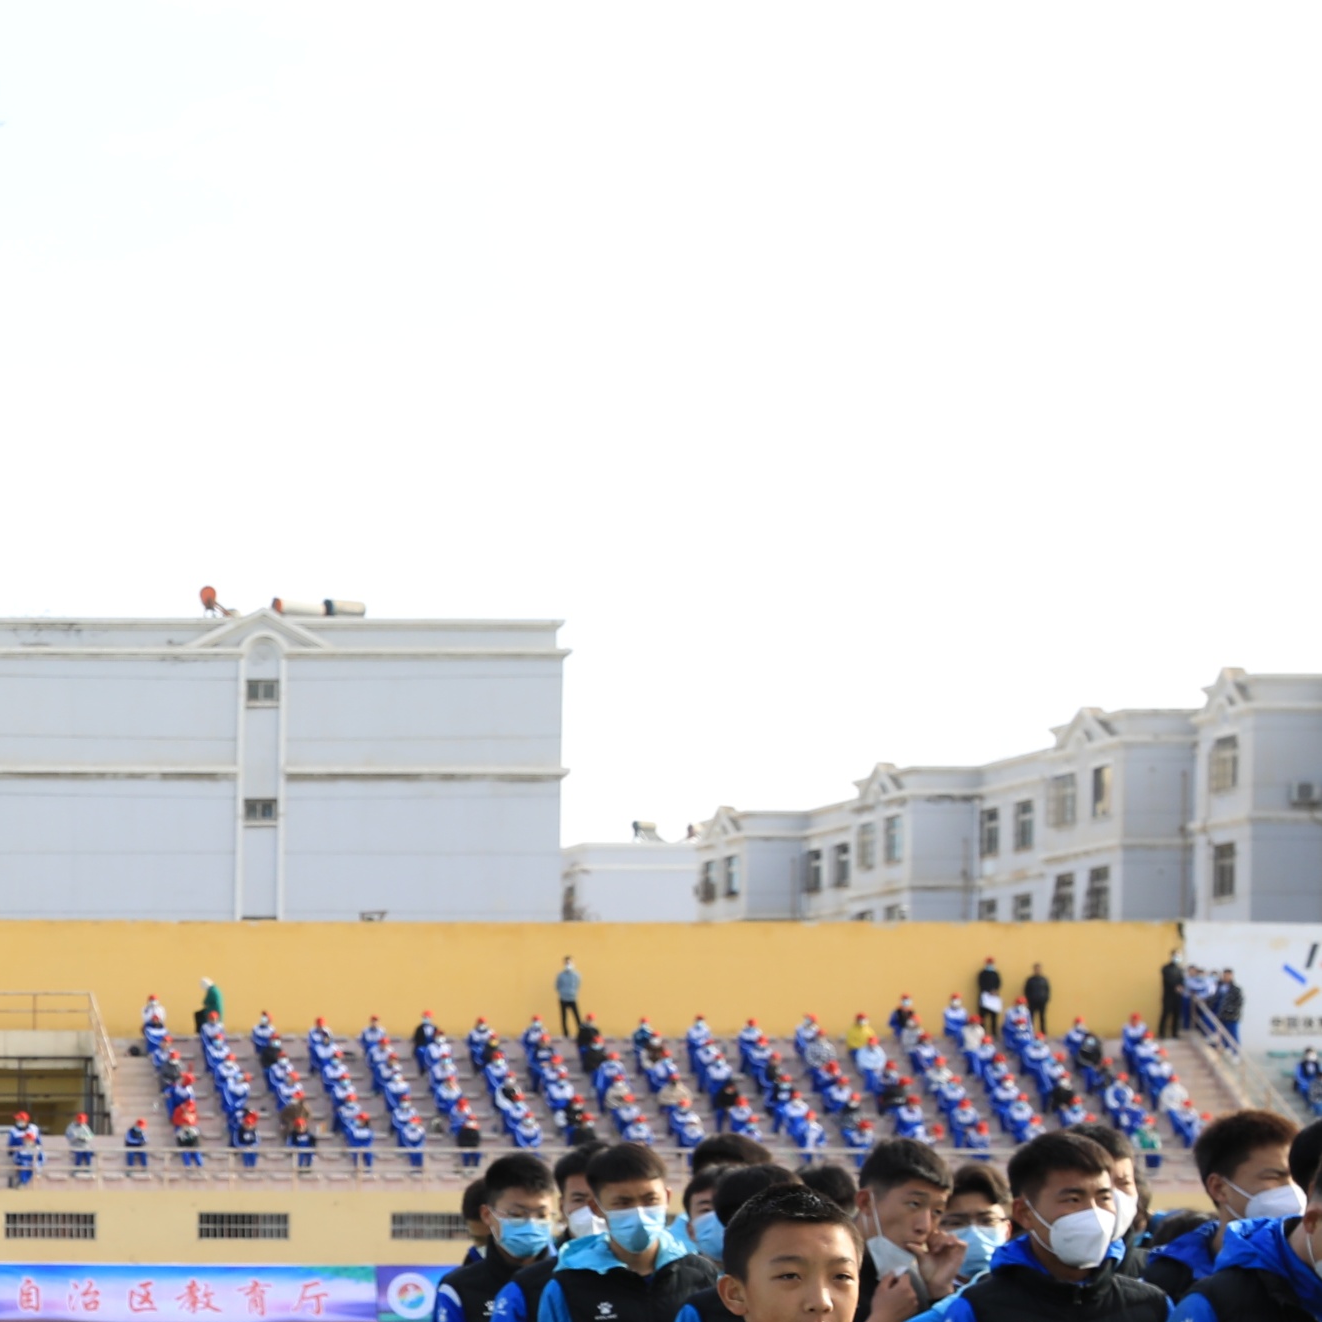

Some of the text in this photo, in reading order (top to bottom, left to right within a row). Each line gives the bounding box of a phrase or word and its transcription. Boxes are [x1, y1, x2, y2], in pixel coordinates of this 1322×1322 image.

[16, 1278, 329, 1316] 自治区教育厅
